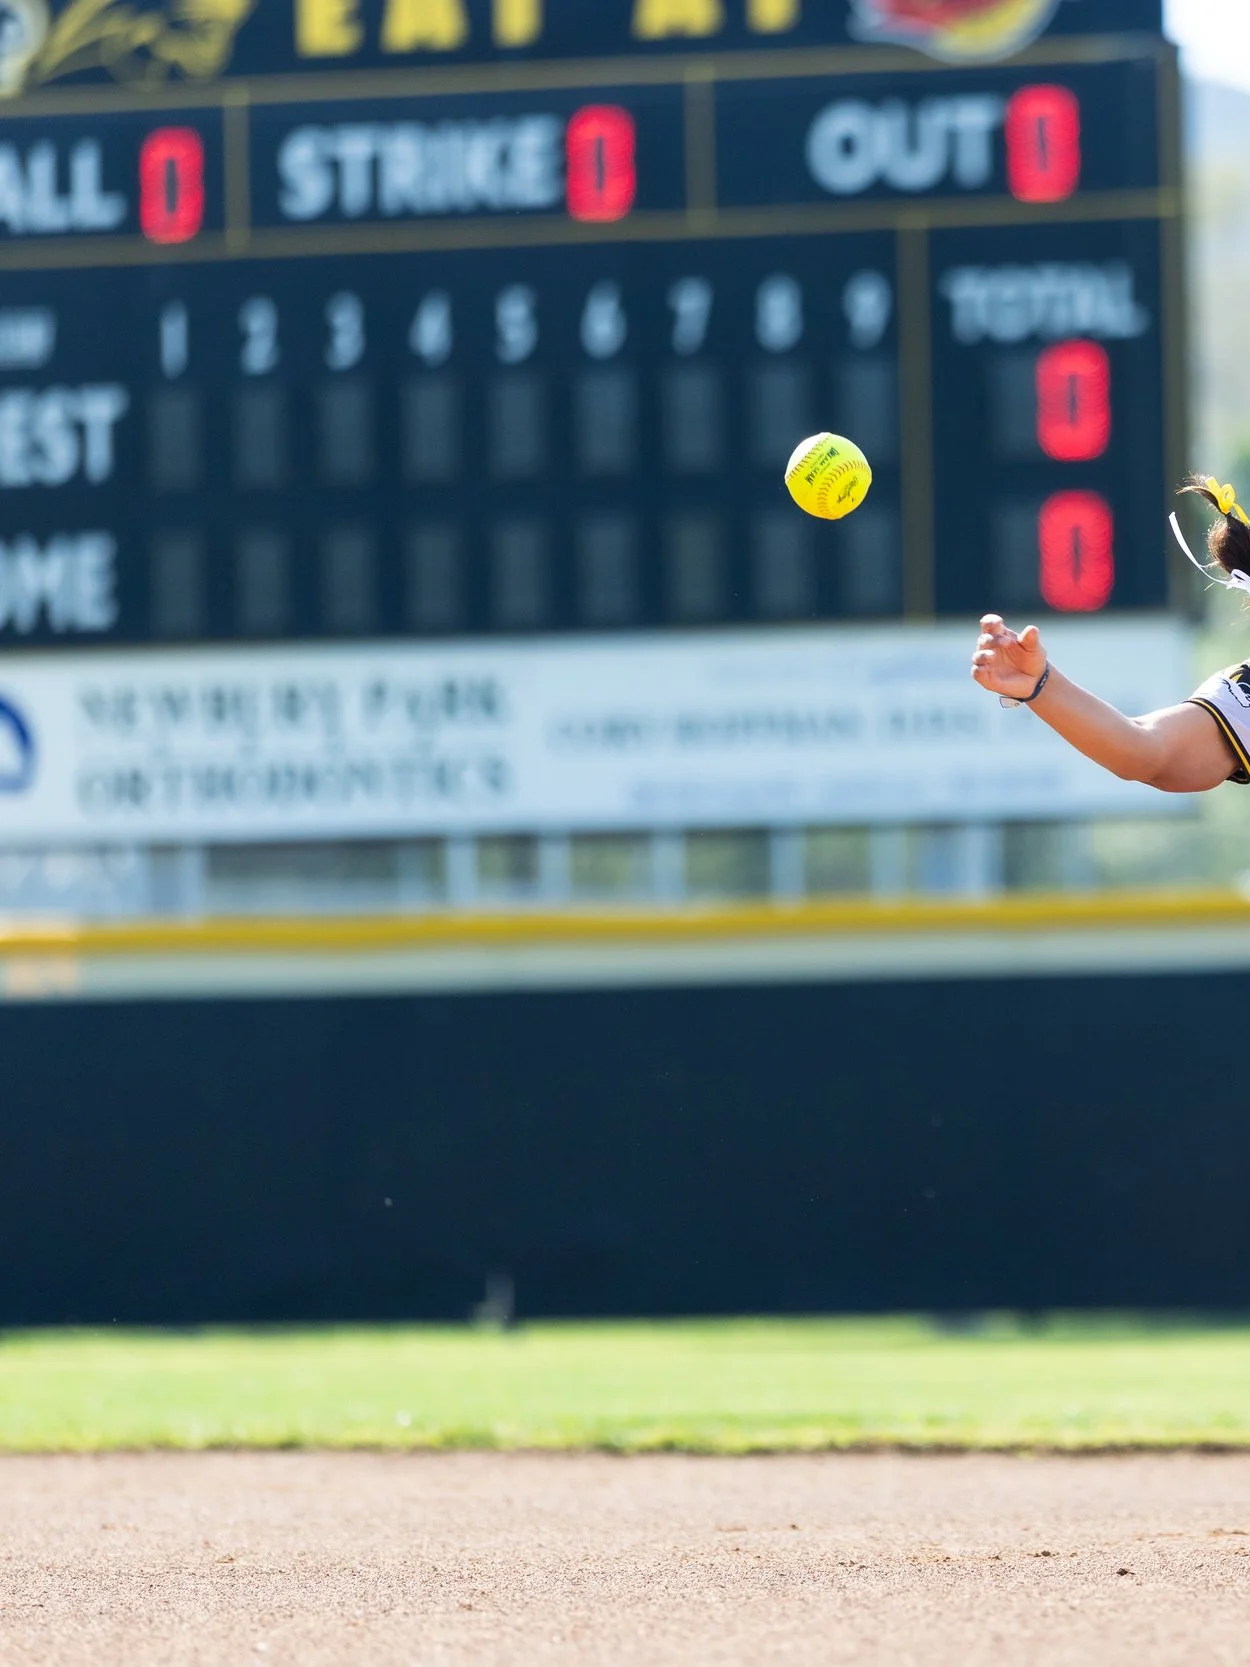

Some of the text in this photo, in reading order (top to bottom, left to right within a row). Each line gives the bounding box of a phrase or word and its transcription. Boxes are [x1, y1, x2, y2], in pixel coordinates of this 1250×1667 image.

[141, 127, 203, 243] 0
[277, 104, 636, 222] STRIKE 0
[806, 84, 1080, 202] OUT 0
[160, 271, 891, 377] 1 2 3 4 5 6 7 8 9
[942, 262, 1148, 342] TOTAL
[1037, 340, 1110, 461] 0
[1039, 490, 1113, 611] 0
